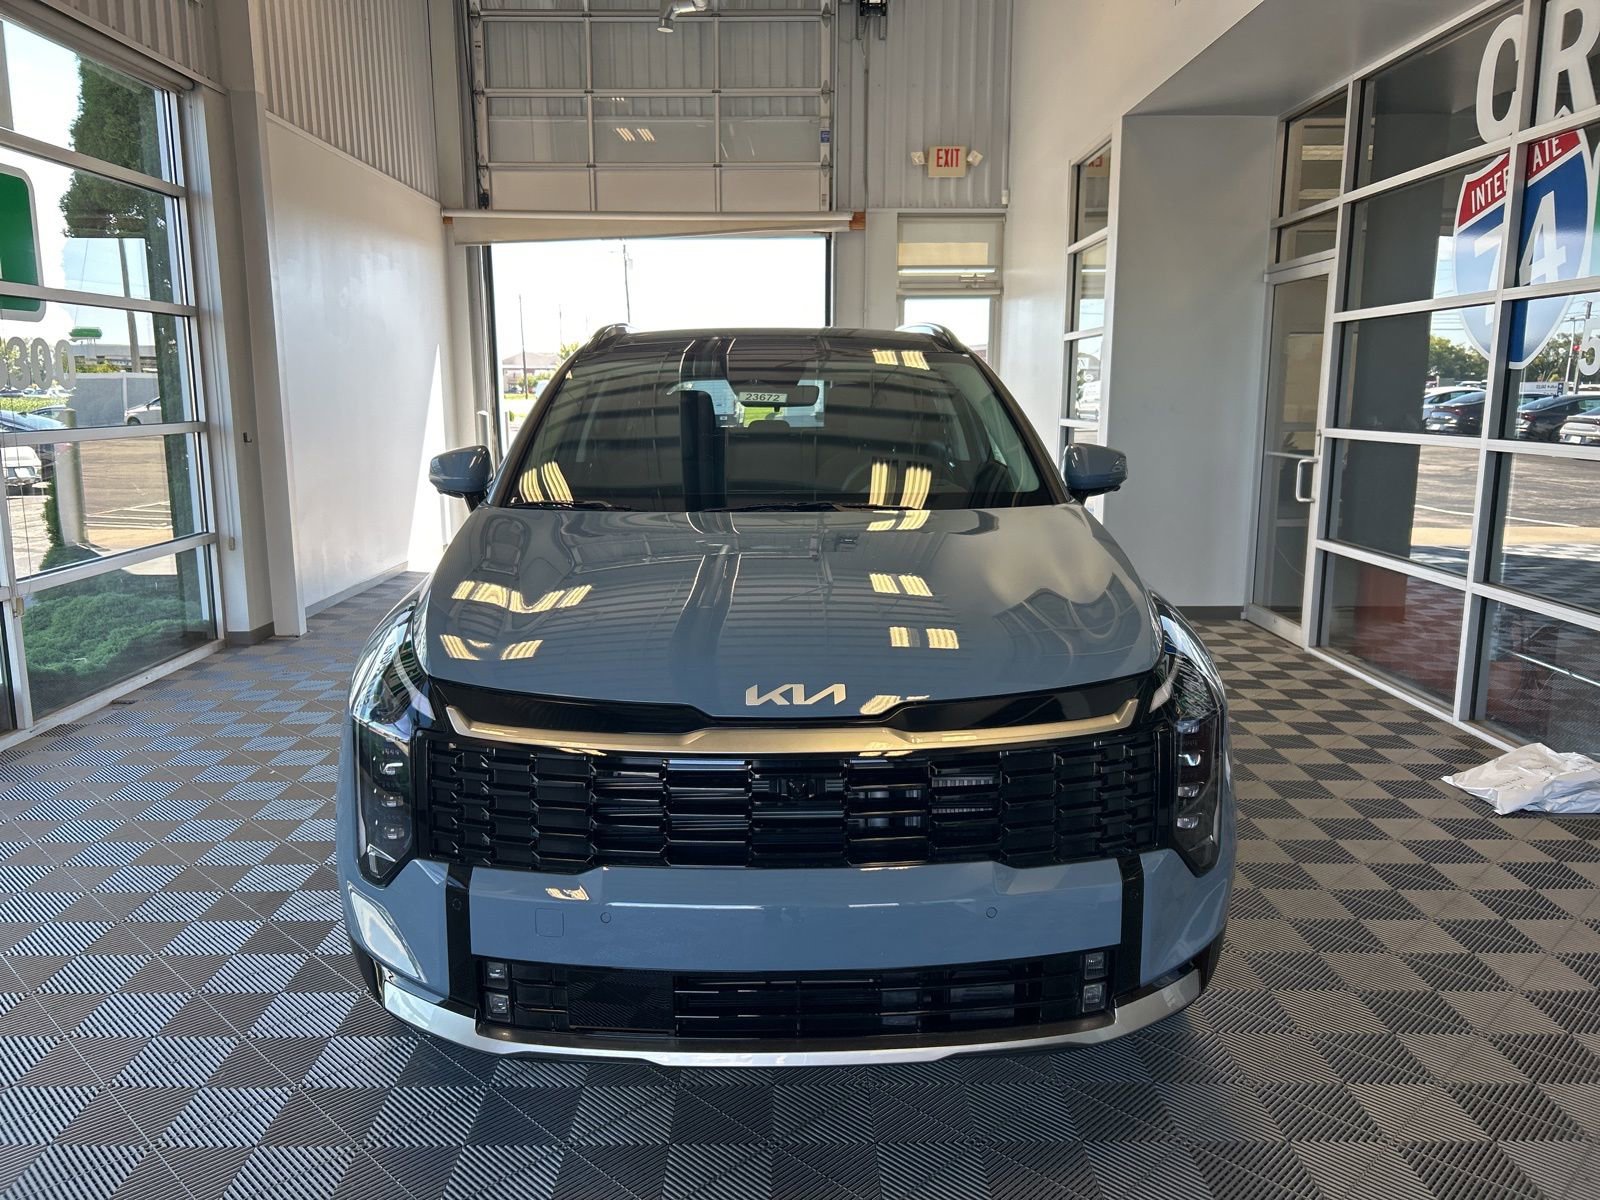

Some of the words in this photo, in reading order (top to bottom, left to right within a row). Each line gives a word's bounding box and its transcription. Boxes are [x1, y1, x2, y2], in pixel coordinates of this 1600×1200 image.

[936, 148, 961, 168] EXIT
[1471, 137, 1562, 214] INTEATE
[746, 393, 780, 402] 23672
[745, 683, 847, 706] KIA
